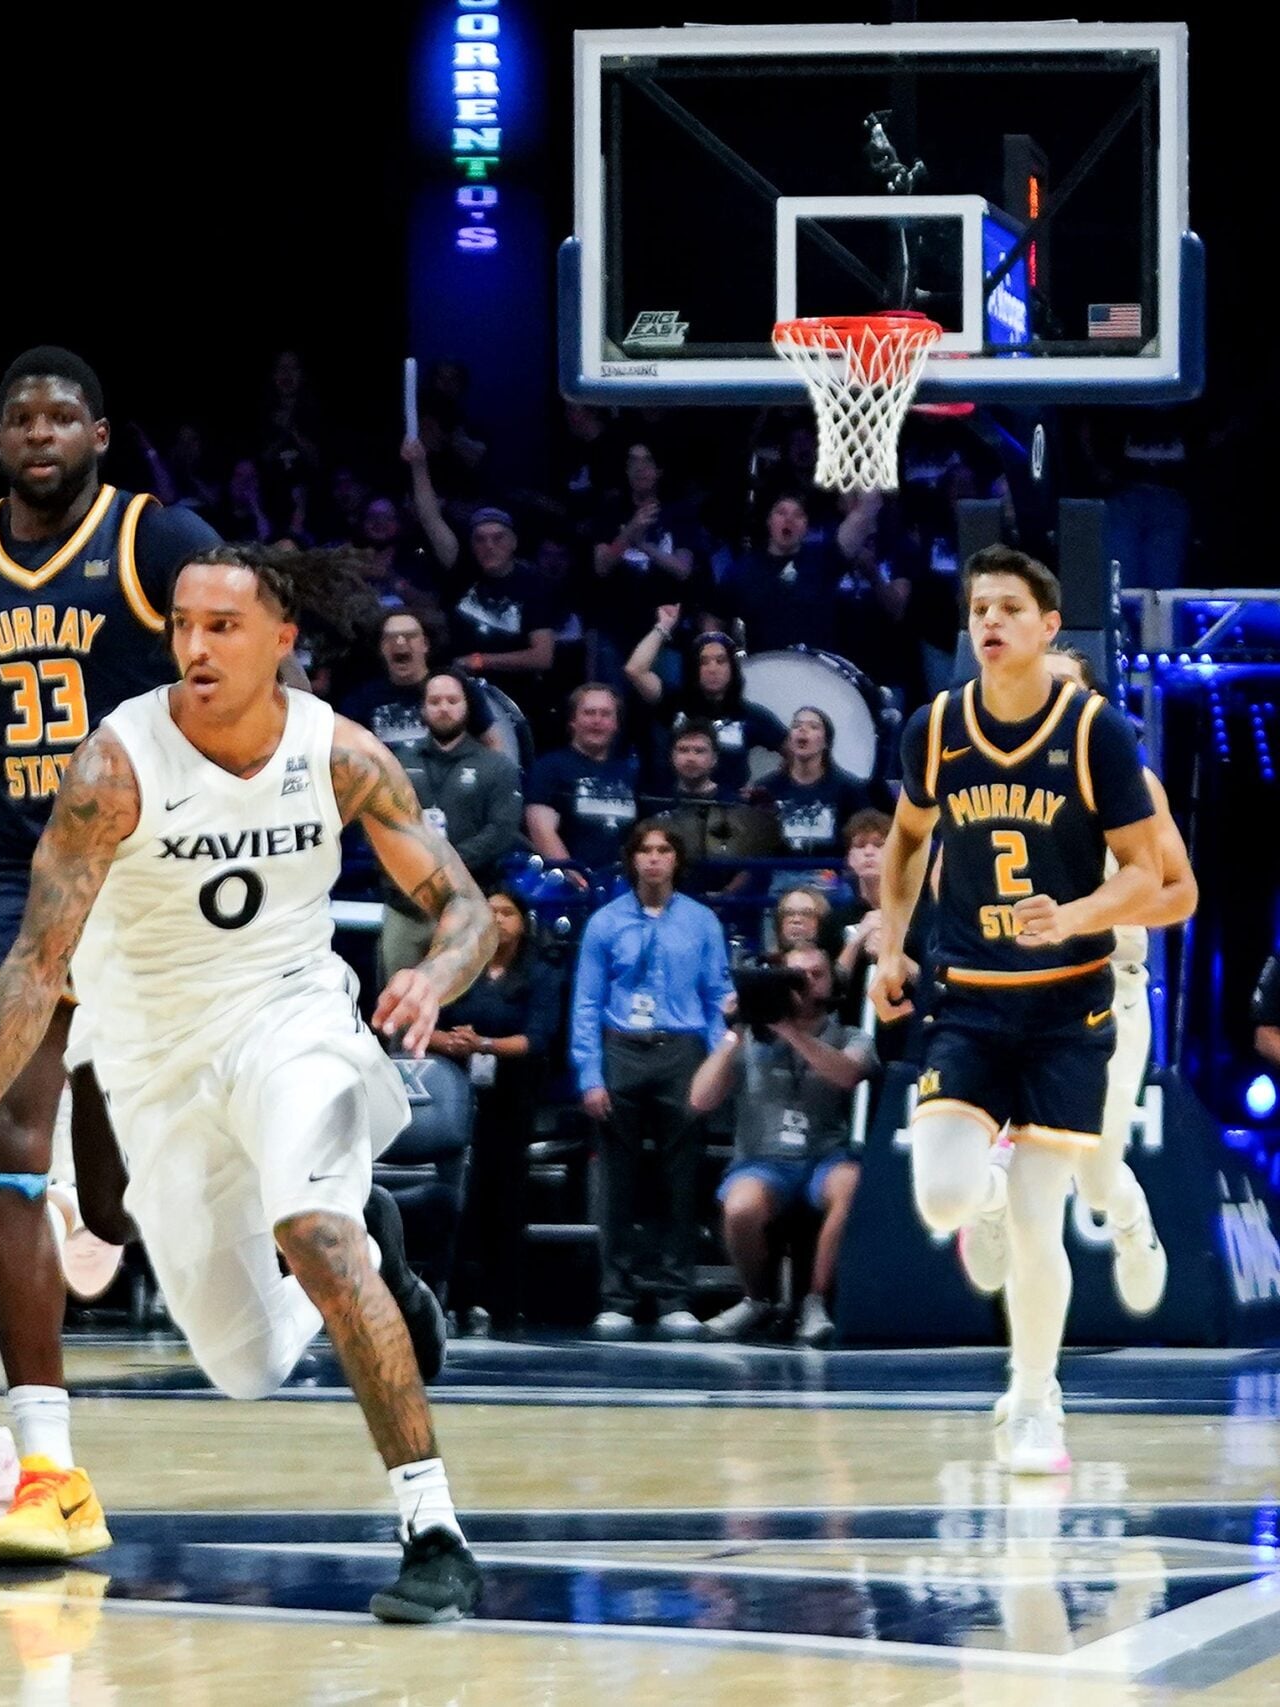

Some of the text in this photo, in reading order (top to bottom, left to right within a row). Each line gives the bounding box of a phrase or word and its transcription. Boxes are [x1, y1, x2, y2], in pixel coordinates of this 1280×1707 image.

[453, 0, 502, 251] ORRENTO'S
[631, 323, 687, 335] EAST
[638, 312, 675, 323] BIG
[947, 783, 1067, 827] MURRAY
[155, 821, 323, 860] XAVIER
[991, 829, 1034, 896] 2
